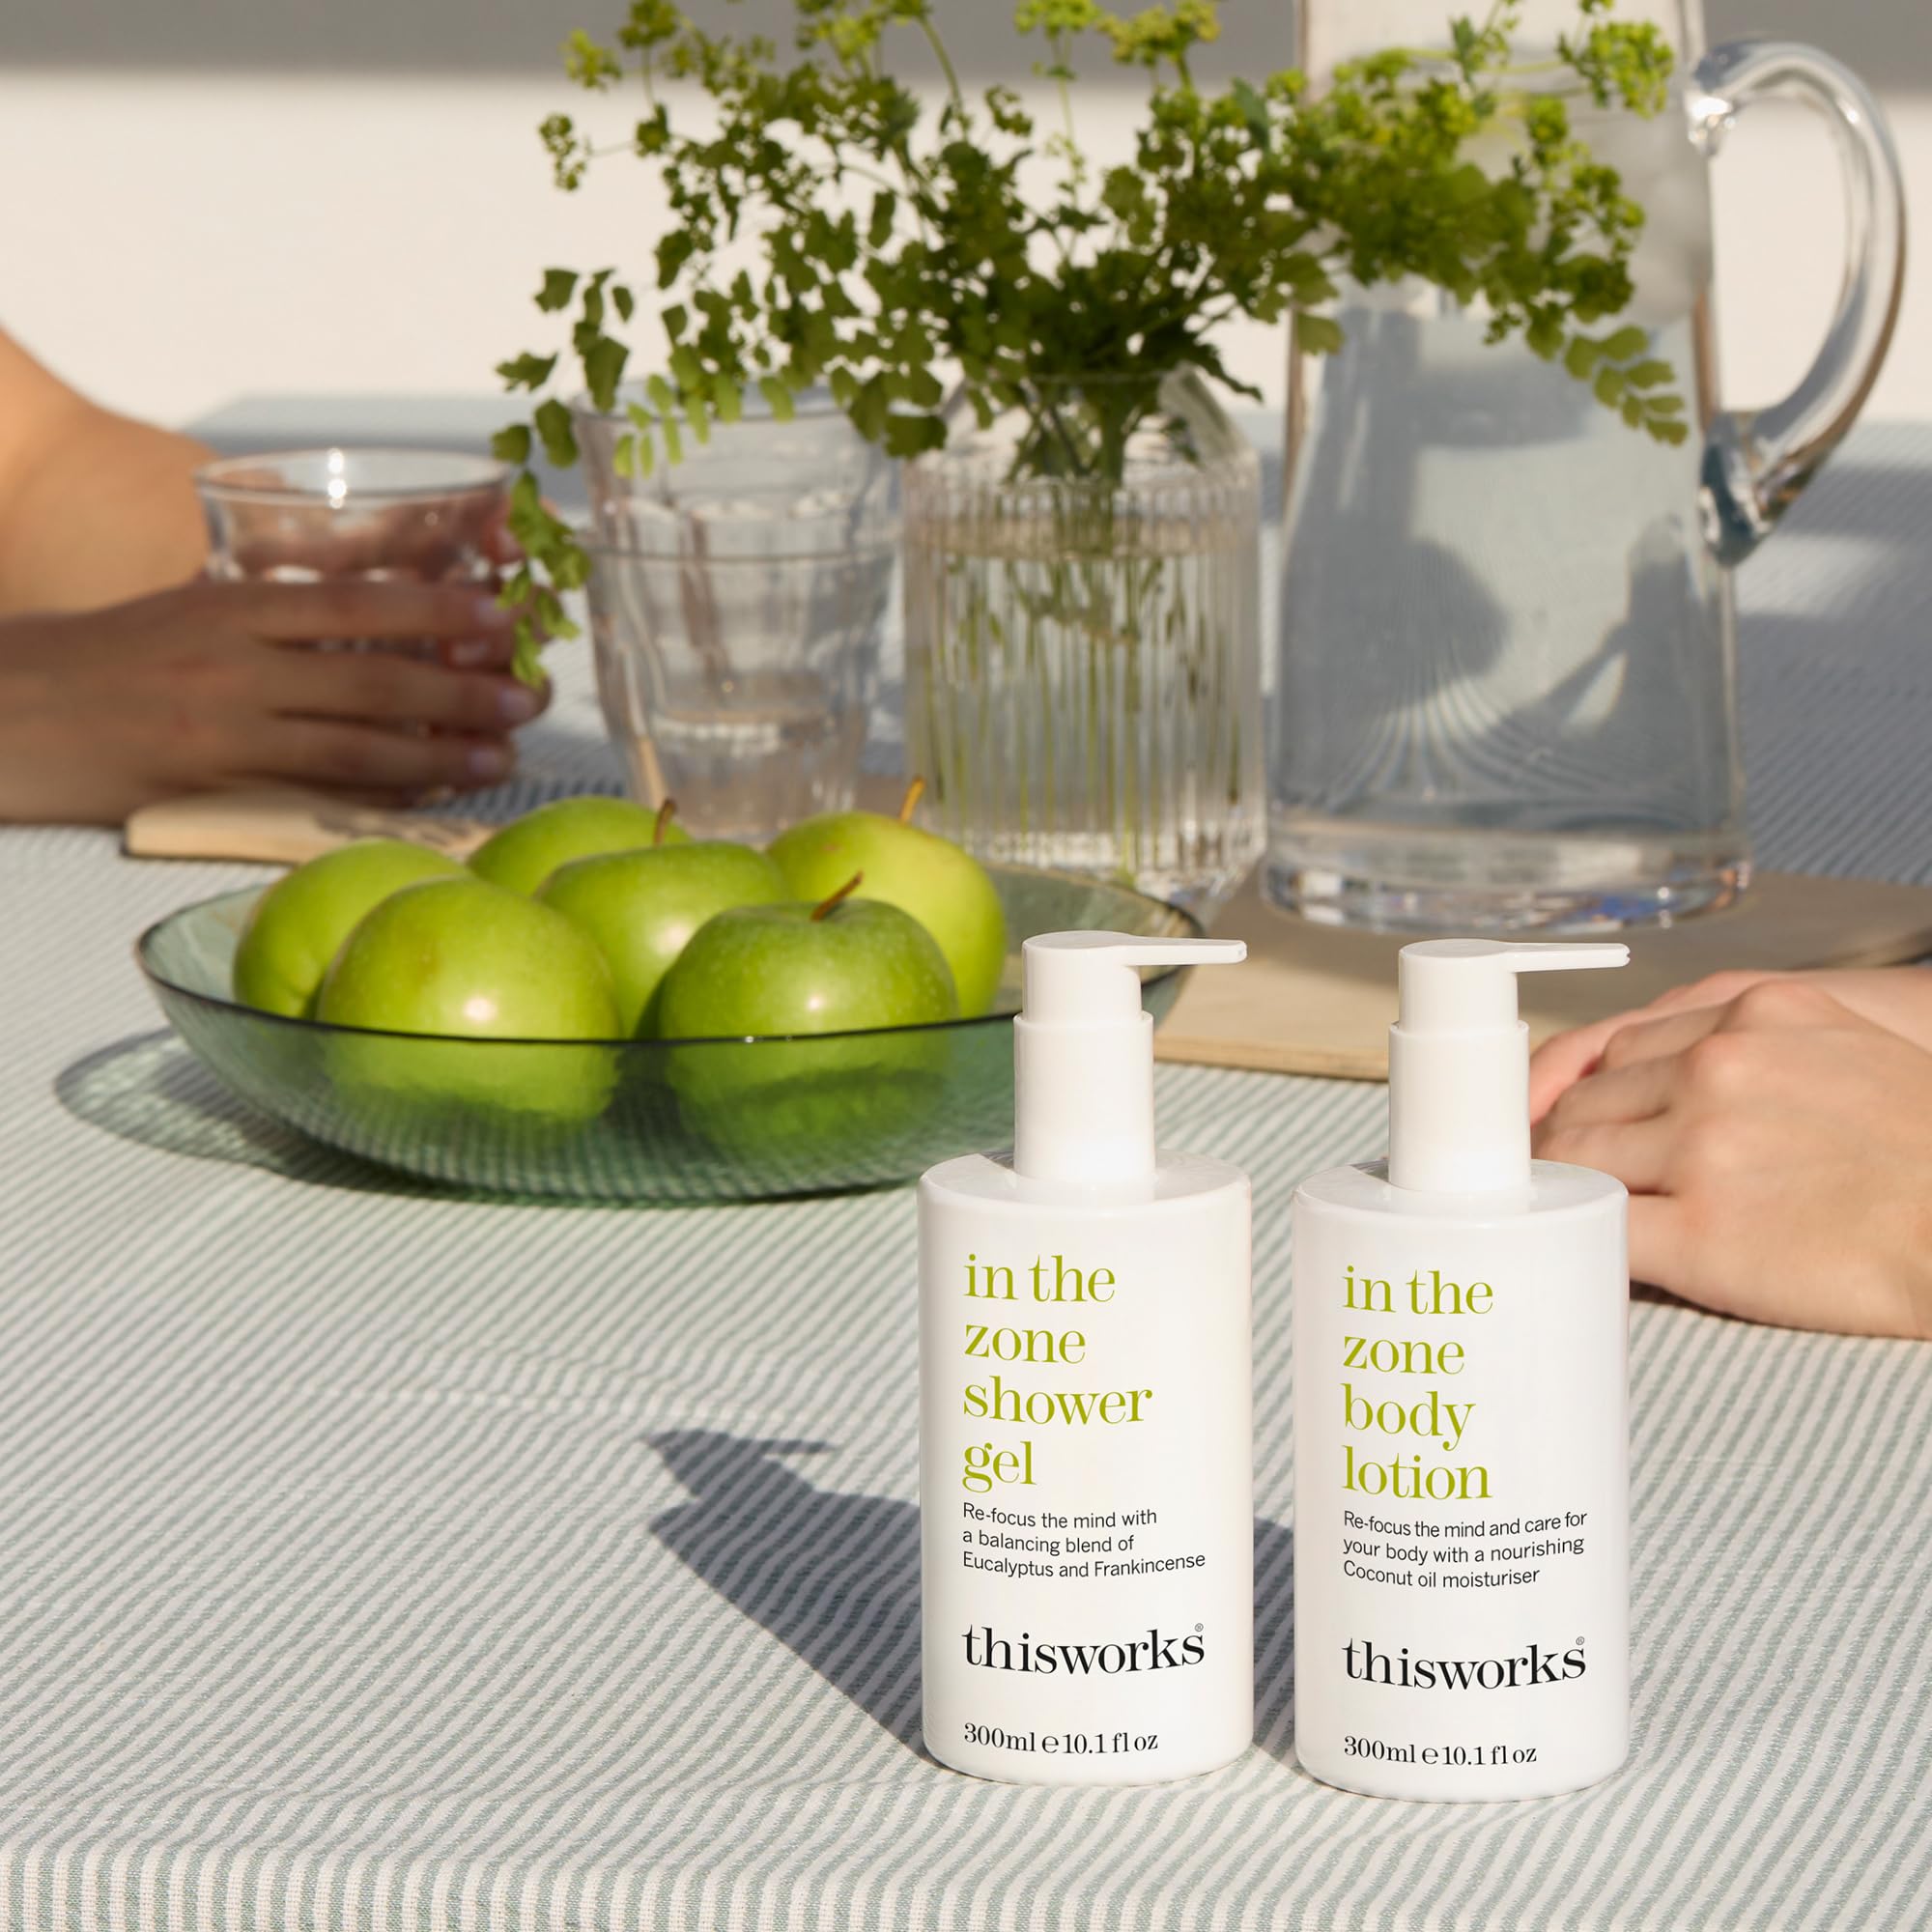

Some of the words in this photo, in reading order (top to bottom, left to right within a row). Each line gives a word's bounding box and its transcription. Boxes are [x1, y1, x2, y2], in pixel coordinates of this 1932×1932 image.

[963, 1253, 1019, 1301] in
[1027, 1254, 1116, 1303] the
[1343, 1264, 1397, 1314] in
[1406, 1269, 1493, 1315] the
[964, 1323, 1087, 1365] zone
[1343, 1335, 1465, 1376] zone
[963, 1375, 1153, 1426] shower
[1340, 1382, 1477, 1452] body
[961, 1440, 1037, 1493] gel
[1342, 1444, 1493, 1500] lotion
[963, 1501, 1037, 1528] Re-focus
[1040, 1512, 1068, 1529] the
[1073, 1511, 1117, 1529] mind
[1121, 1508, 1157, 1527] with
[1344, 1510, 1412, 1537] Re-focus
[1413, 1520, 1440, 1538] the
[1444, 1520, 1486, 1538] mind
[1489, 1517, 1520, 1537] and
[1524, 1517, 1562, 1534] care
[1564, 1511, 1588, 1528] for
[962, 1530, 973, 1544] a
[979, 1529, 1062, 1557] balancing
[1065, 1536, 1113, 1554] blend
[1118, 1534, 1135, 1551] of
[1342, 1538, 1381, 1557] your
[1385, 1542, 1429, 1567] body
[1433, 1546, 1469, 1564] with
[1474, 1549, 1485, 1563] a
[1491, 1537, 1585, 1562] nourishing
[963, 1550, 1054, 1579] Eucalyptus
[1058, 1561, 1090, 1578] and
[1094, 1554, 1206, 1577] Frankincense
[1343, 1559, 1413, 1587] Coconut
[1417, 1571, 1436, 1588] oil
[1442, 1568, 1541, 1589] moisturiser
